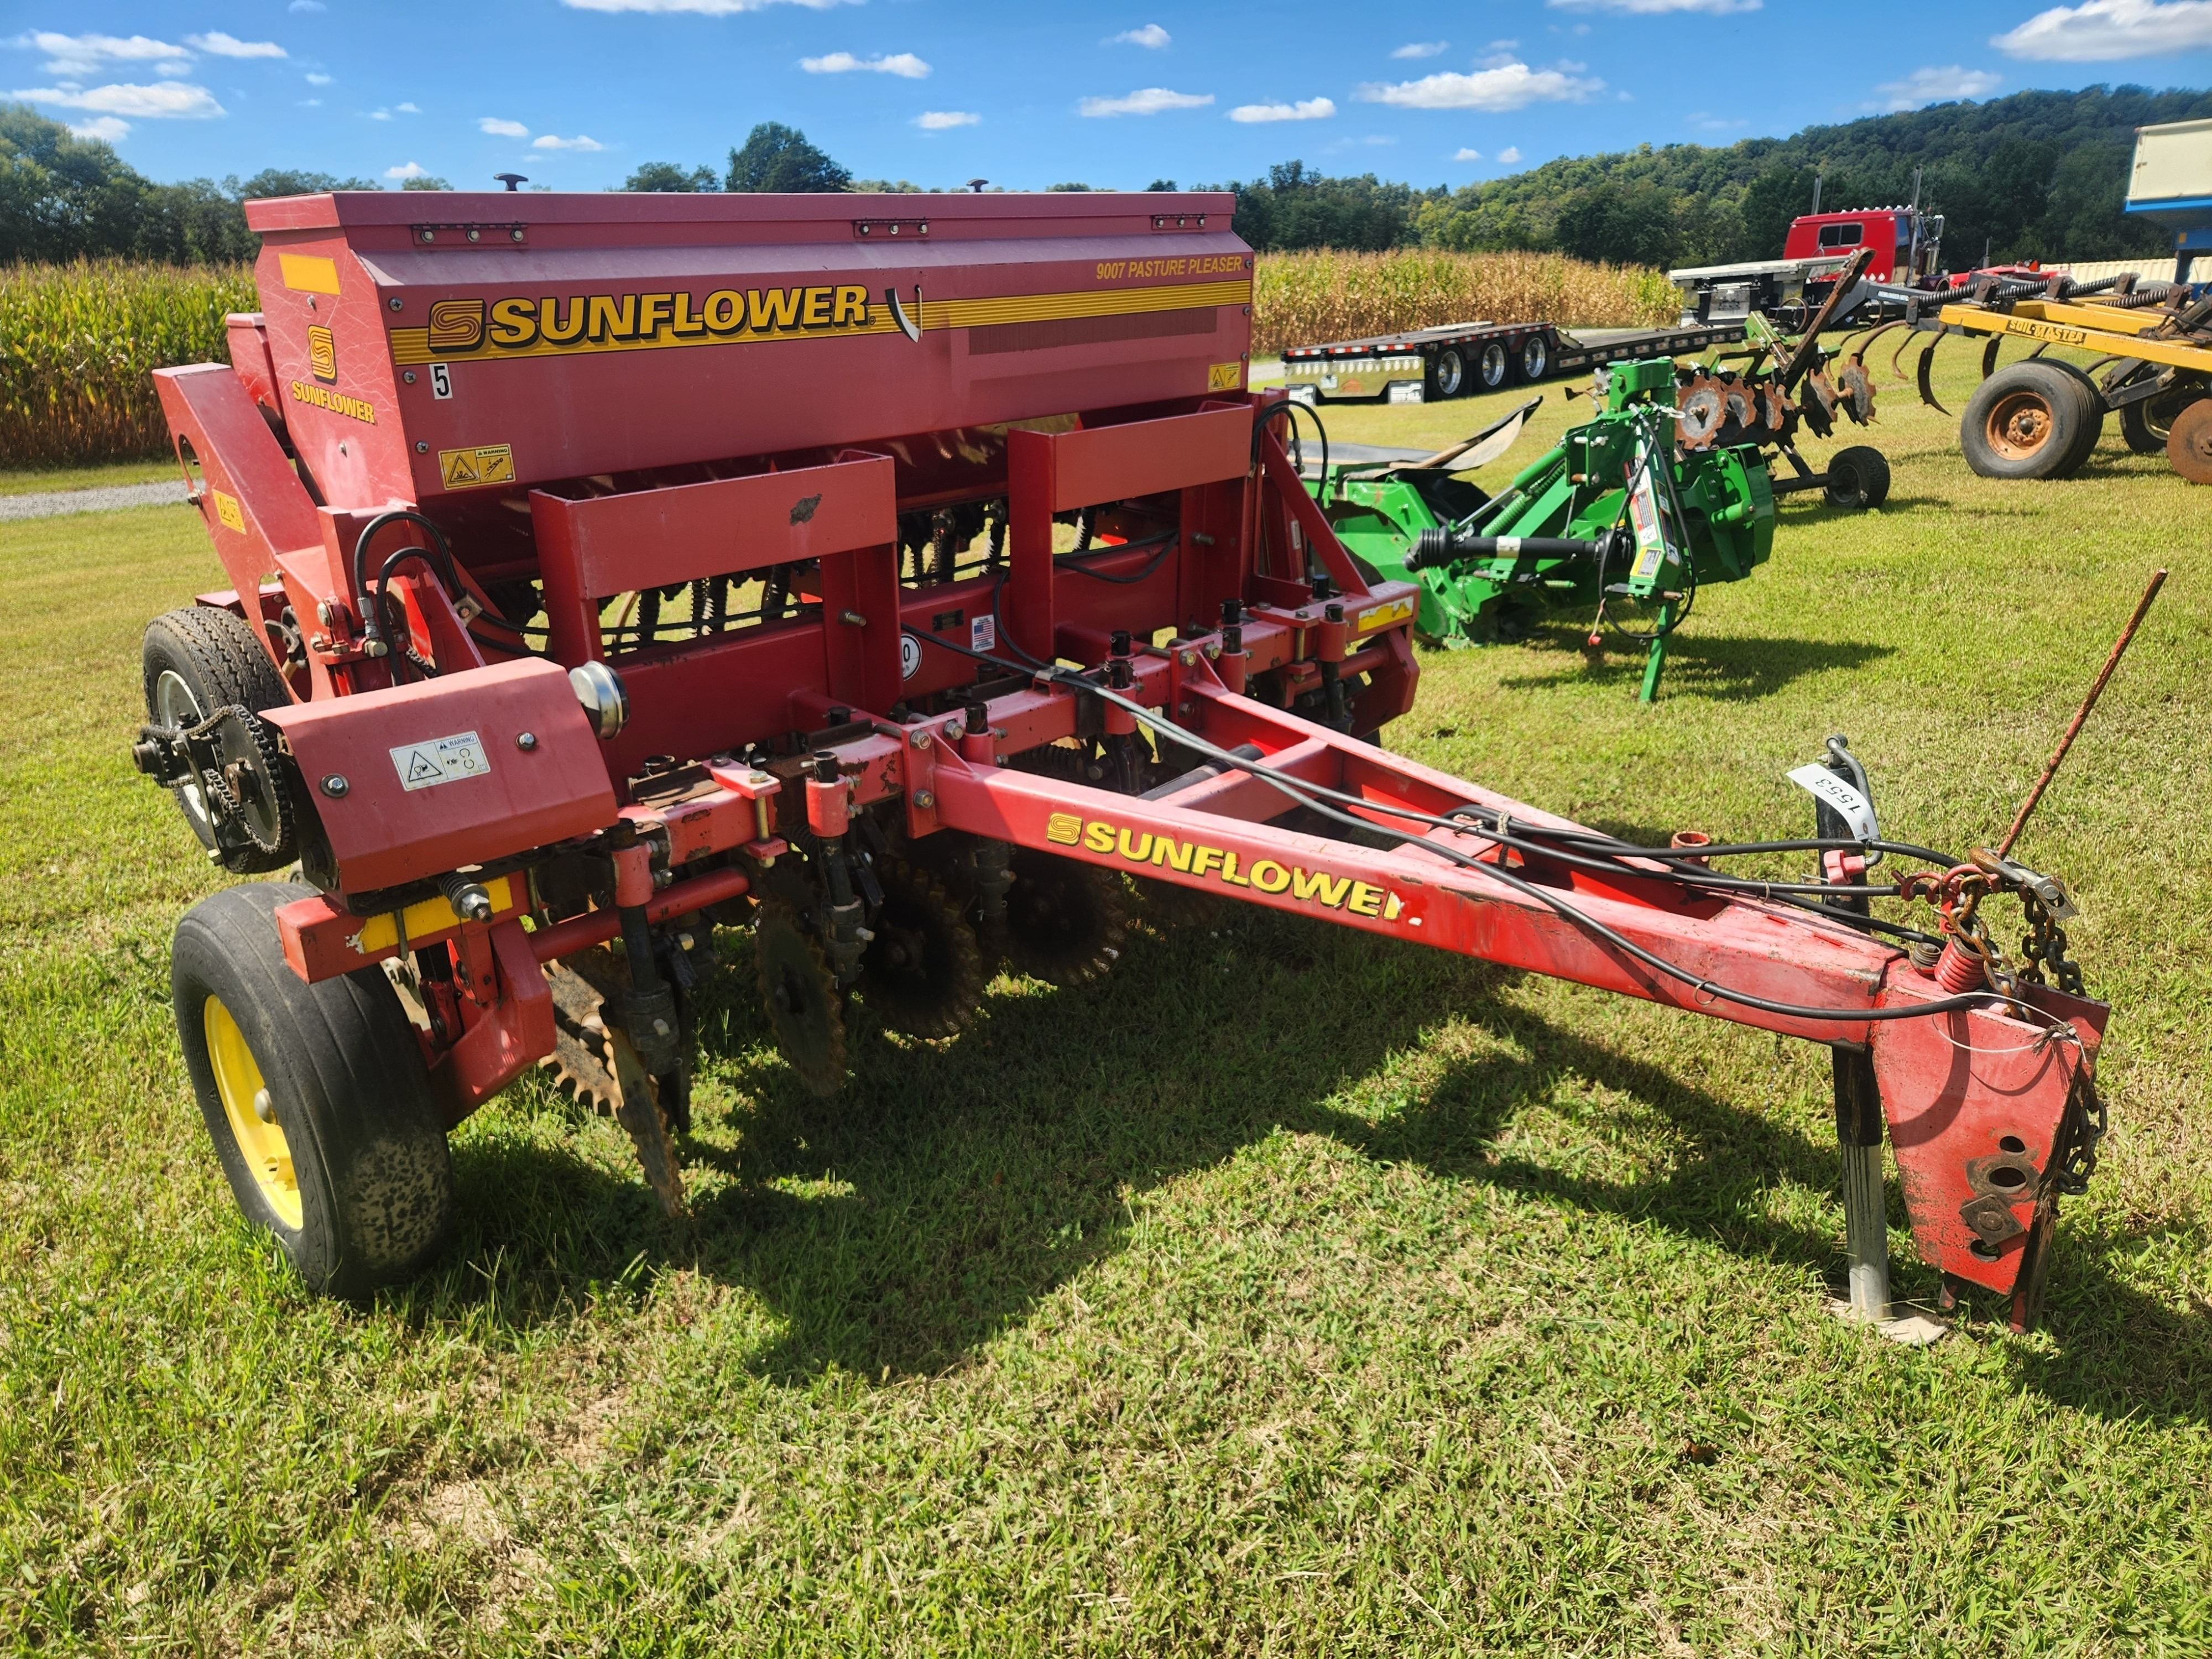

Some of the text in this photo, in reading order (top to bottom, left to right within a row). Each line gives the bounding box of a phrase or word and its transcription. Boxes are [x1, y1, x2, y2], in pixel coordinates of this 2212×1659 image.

[1097, 256, 1242, 280] 9007 PASTURE PLEASER
[434, 366, 450, 396] 5
[292, 380, 375, 424] SUNFLOWER
[903, 644, 910, 662] 0
[449, 736, 474, 746] WARNING
[1815, 779, 1861, 813] 1553
